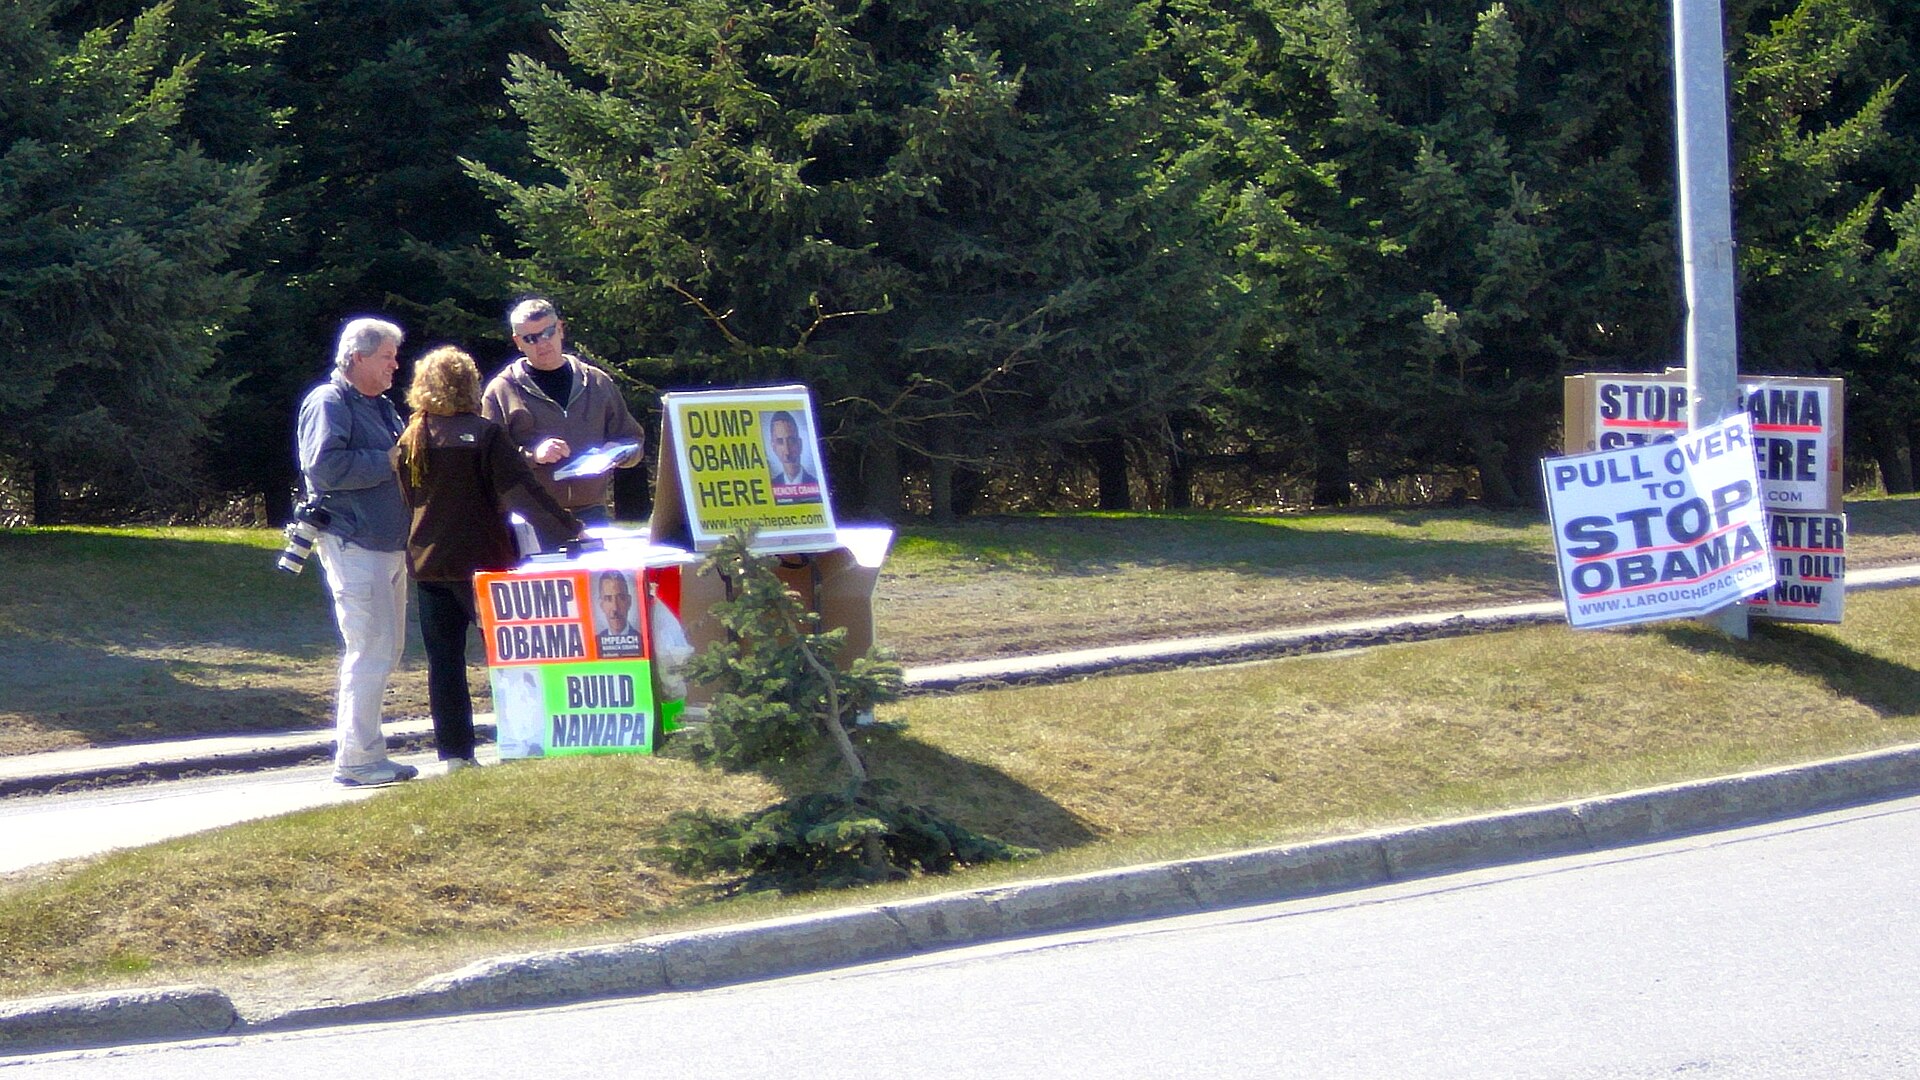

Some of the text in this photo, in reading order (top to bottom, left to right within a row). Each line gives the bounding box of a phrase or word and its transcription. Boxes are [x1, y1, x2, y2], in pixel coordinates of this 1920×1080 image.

[1600, 383, 1823, 427] STOP AMA
[687, 409, 754, 439] DUMP
[688, 442, 765, 472] OBAMA
[1554, 454, 1653, 491] PULL
[1664, 424, 1748, 475] OVER
[1752, 437, 1817, 481] ERE
[698, 479, 768, 508] HERE
[1641, 480, 1686, 501] TO
[700, 513, 824, 531] www.larochepac.com
[1563, 479, 1753, 559] STOP
[1768, 514, 1844, 549] ATER
[1571, 524, 1764, 596] OBAMA
[490, 579, 574, 621] DUMP
[1578, 562, 1764, 616] WWW.LAROUCHEPAC.COM
[1774, 580, 1823, 604] NOW
[496, 623, 585, 660] OBAMA
[601, 635, 639, 645] IMPEACH
[566, 674, 635, 709] BUILD
[552, 712, 646, 748] NAWAPA
